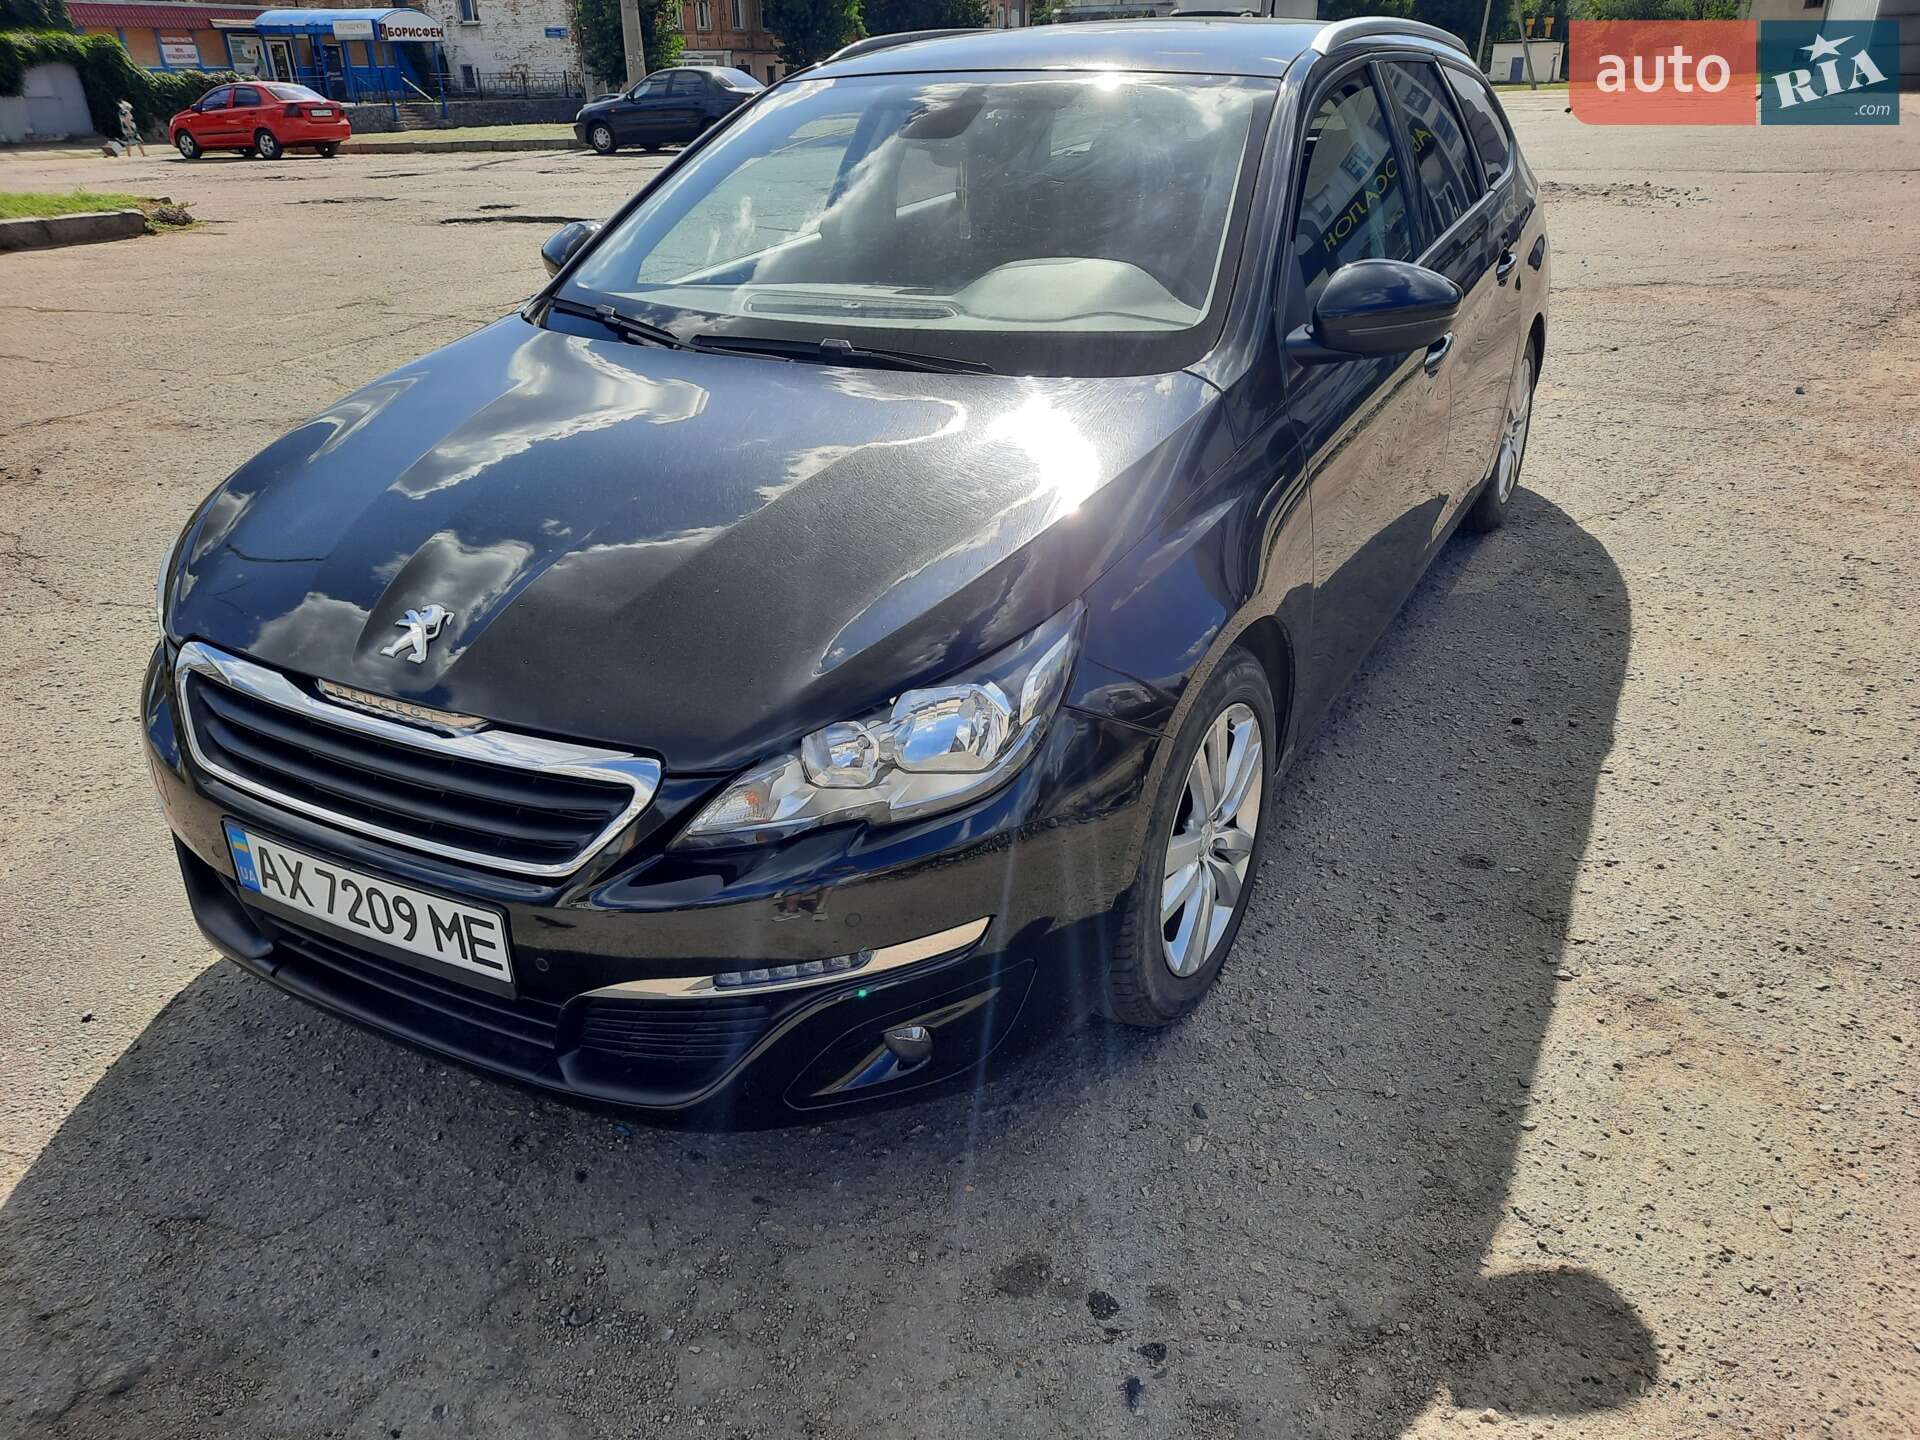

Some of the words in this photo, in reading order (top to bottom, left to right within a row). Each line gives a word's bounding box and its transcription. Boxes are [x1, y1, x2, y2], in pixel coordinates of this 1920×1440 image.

[387, 27, 444, 37] БОРИСФЕН
[334, 687, 436, 720] PEUGEOT
[239, 865, 258, 883] UA
[257, 846, 314, 908] AX
[315, 867, 418, 942] 7209
[427, 904, 503, 971] ME
